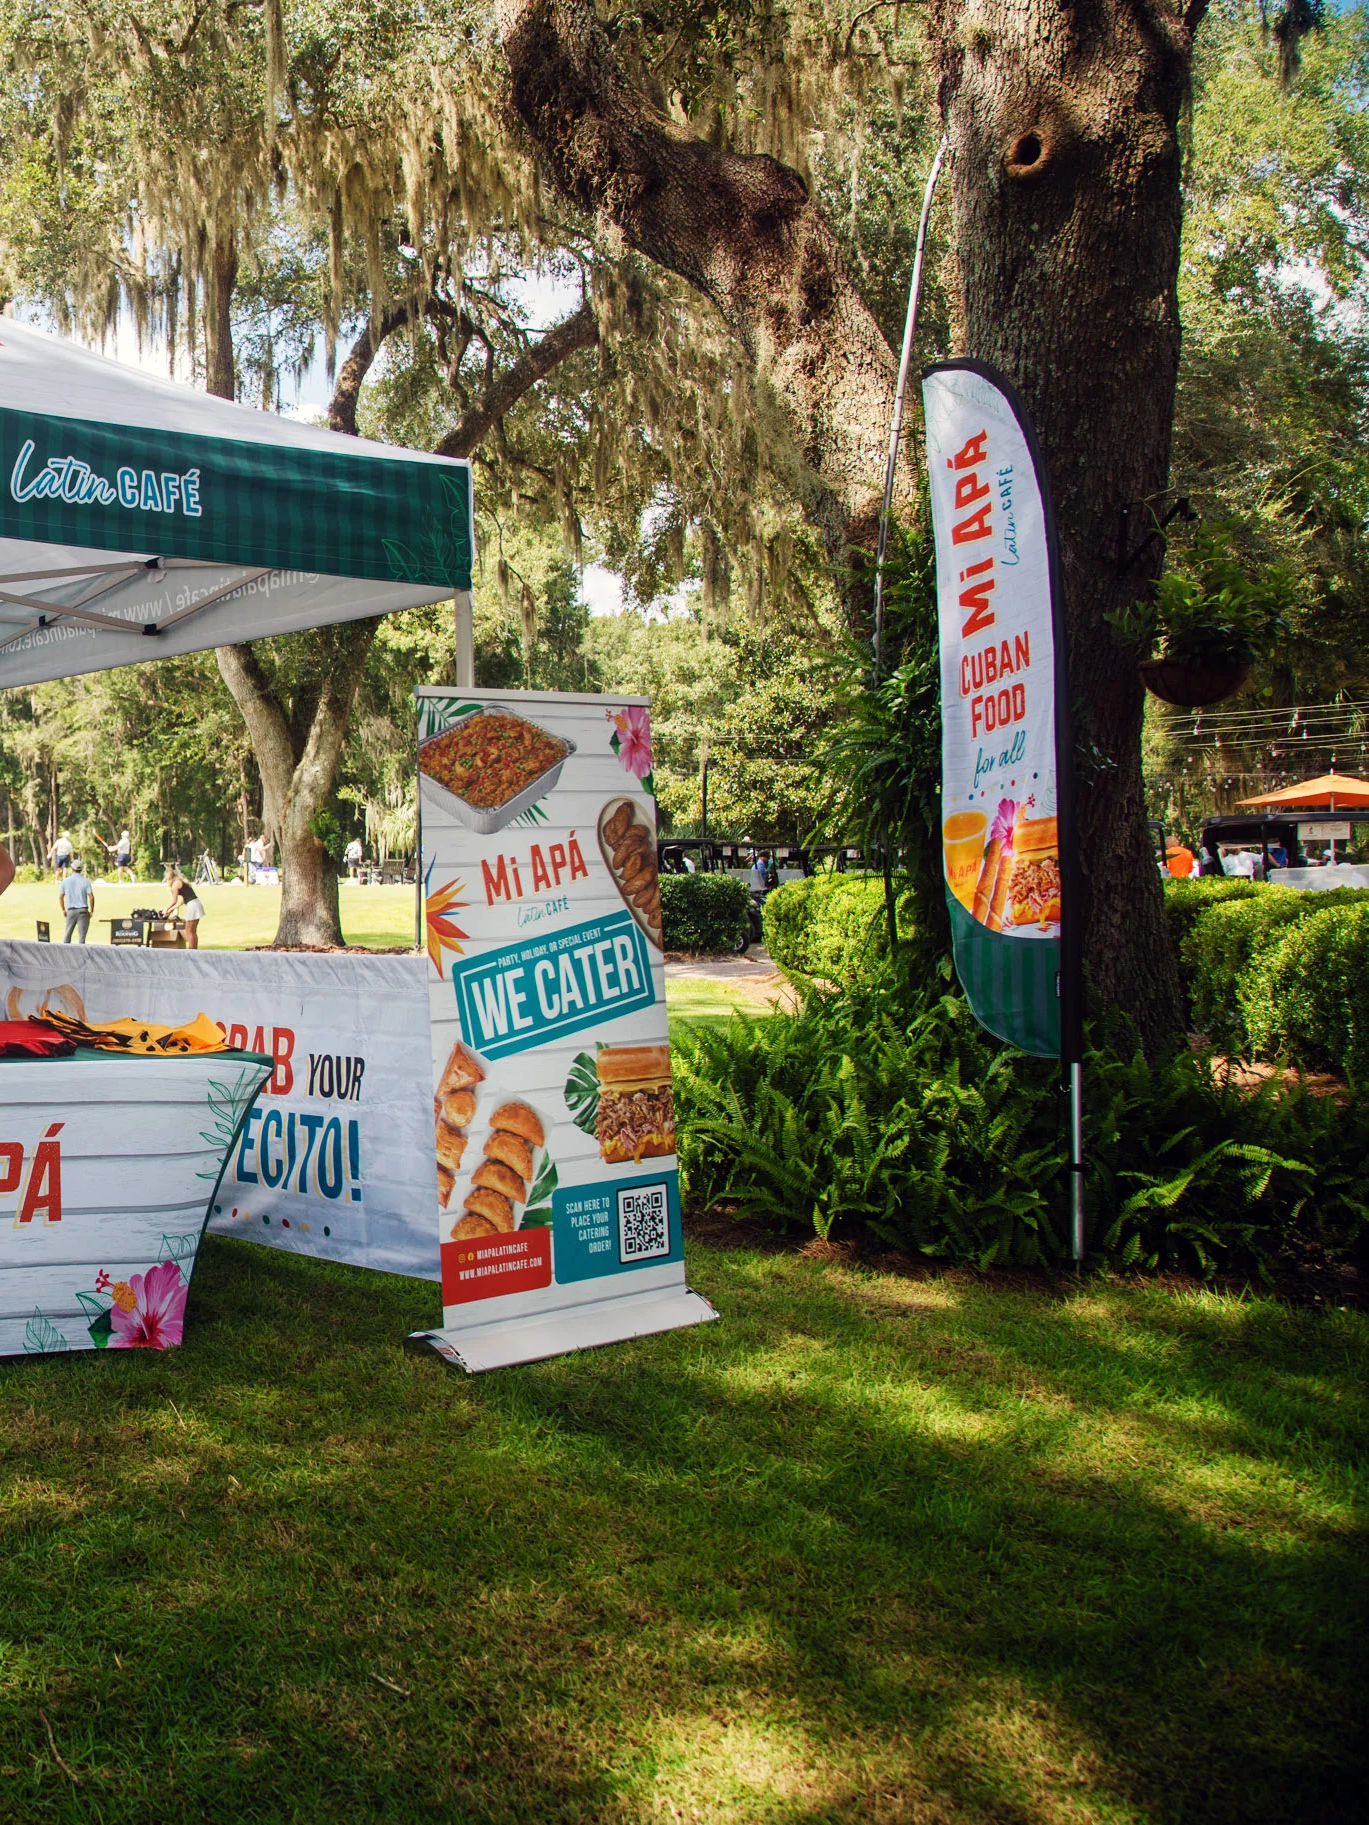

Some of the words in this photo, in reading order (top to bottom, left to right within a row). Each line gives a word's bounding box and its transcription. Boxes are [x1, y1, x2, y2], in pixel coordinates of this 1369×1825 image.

[11, 439, 117, 505] Latin
[117, 467, 203, 517] CAFÉ
[947, 429, 993, 546] APÁ
[996, 464, 1014, 511] CAFÉ
[1001, 511, 1020, 566] Latin
[959, 557, 995, 640] Mi
[959, 630, 1030, 698] CUBAN
[971, 683, 1026, 741] FOOD
[973, 747, 995, 789] for
[999, 730, 1026, 767] all
[481, 854, 523, 907] Mi
[530, 829, 589, 892] APÁ
[517, 906, 545, 927] Latin
[546, 894, 570, 916] CAFÉ
[498, 953, 520, 968] PARTY,
[549, 941, 558, 953] OR
[558, 933, 582, 949] SPECIAL
[582, 928, 601, 942] EVENT
[471, 967, 533, 1040] WE
[534, 934, 641, 1020] CATER
[308, 1054, 365, 1101] YOUR
[566, 1201, 583, 1214] SCAN
[584, 1199, 601, 1211] HERE
[601, 1197, 610, 1208] TO
[571, 1215, 591, 1228] PLACE
[591, 1212, 609, 1225] YOUR
[477, 1242, 528, 1260] MIAPALATINCAFE
[578, 1226, 610, 1241] CATERING
[588, 1240, 612, 1254] ORDER!
[459, 1257, 543, 1281] WWW.MIAPALATINCAFE.COM
